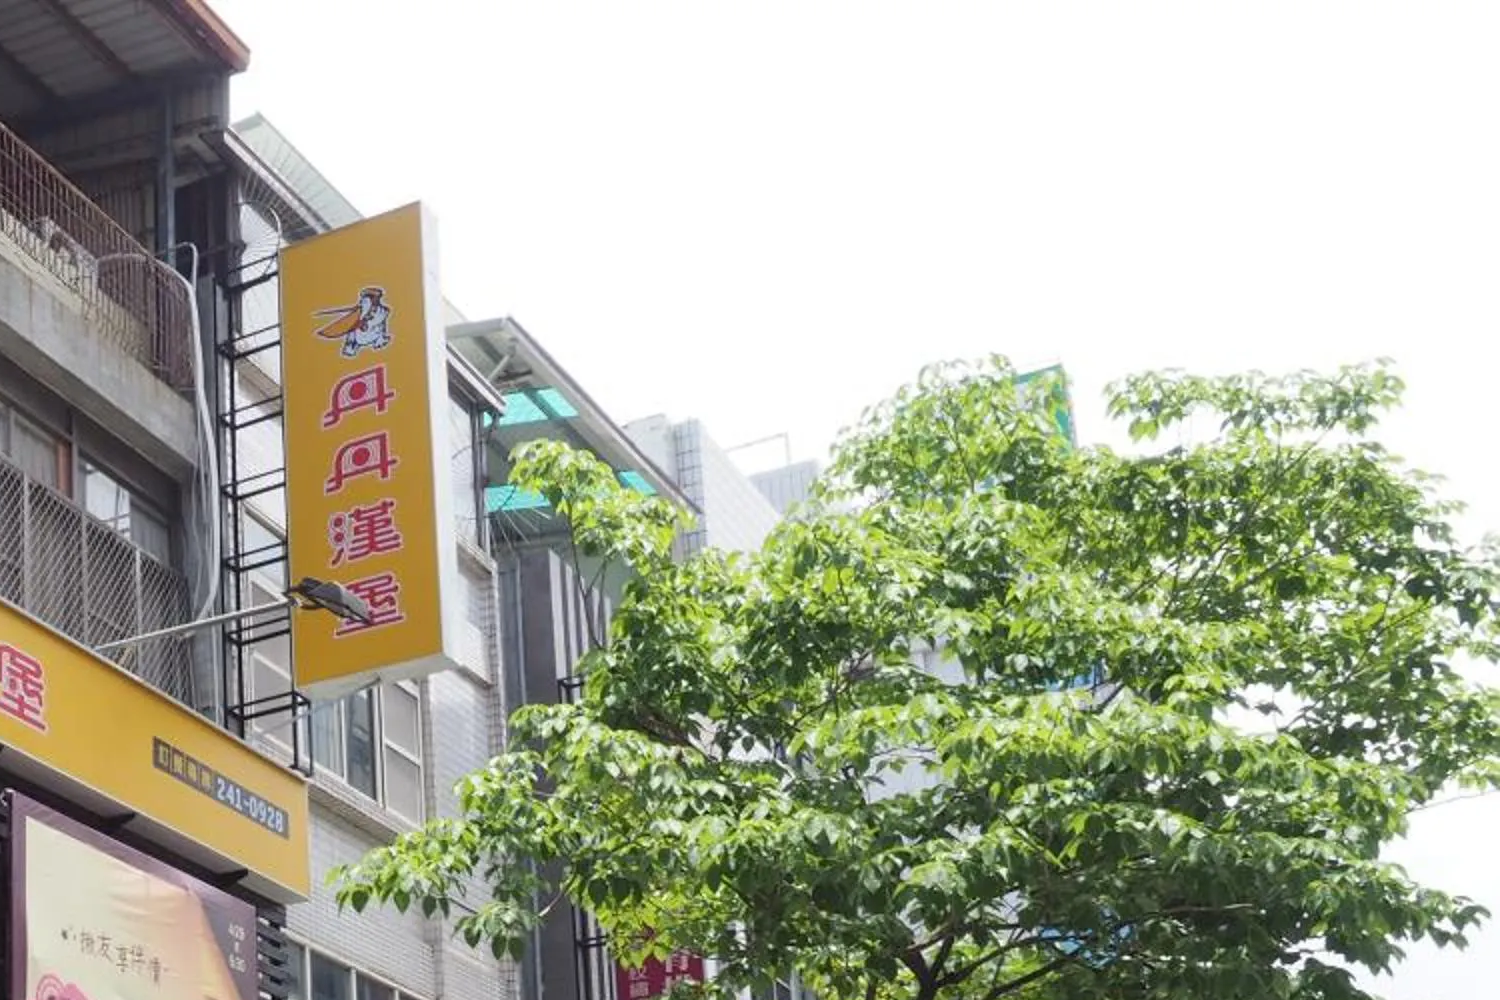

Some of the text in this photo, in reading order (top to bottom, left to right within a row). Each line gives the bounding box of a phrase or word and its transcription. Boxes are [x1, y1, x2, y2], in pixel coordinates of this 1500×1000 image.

[324, 362, 404, 637] 丹丹漢堡
[216, 775, 284, 833] 241-0928
